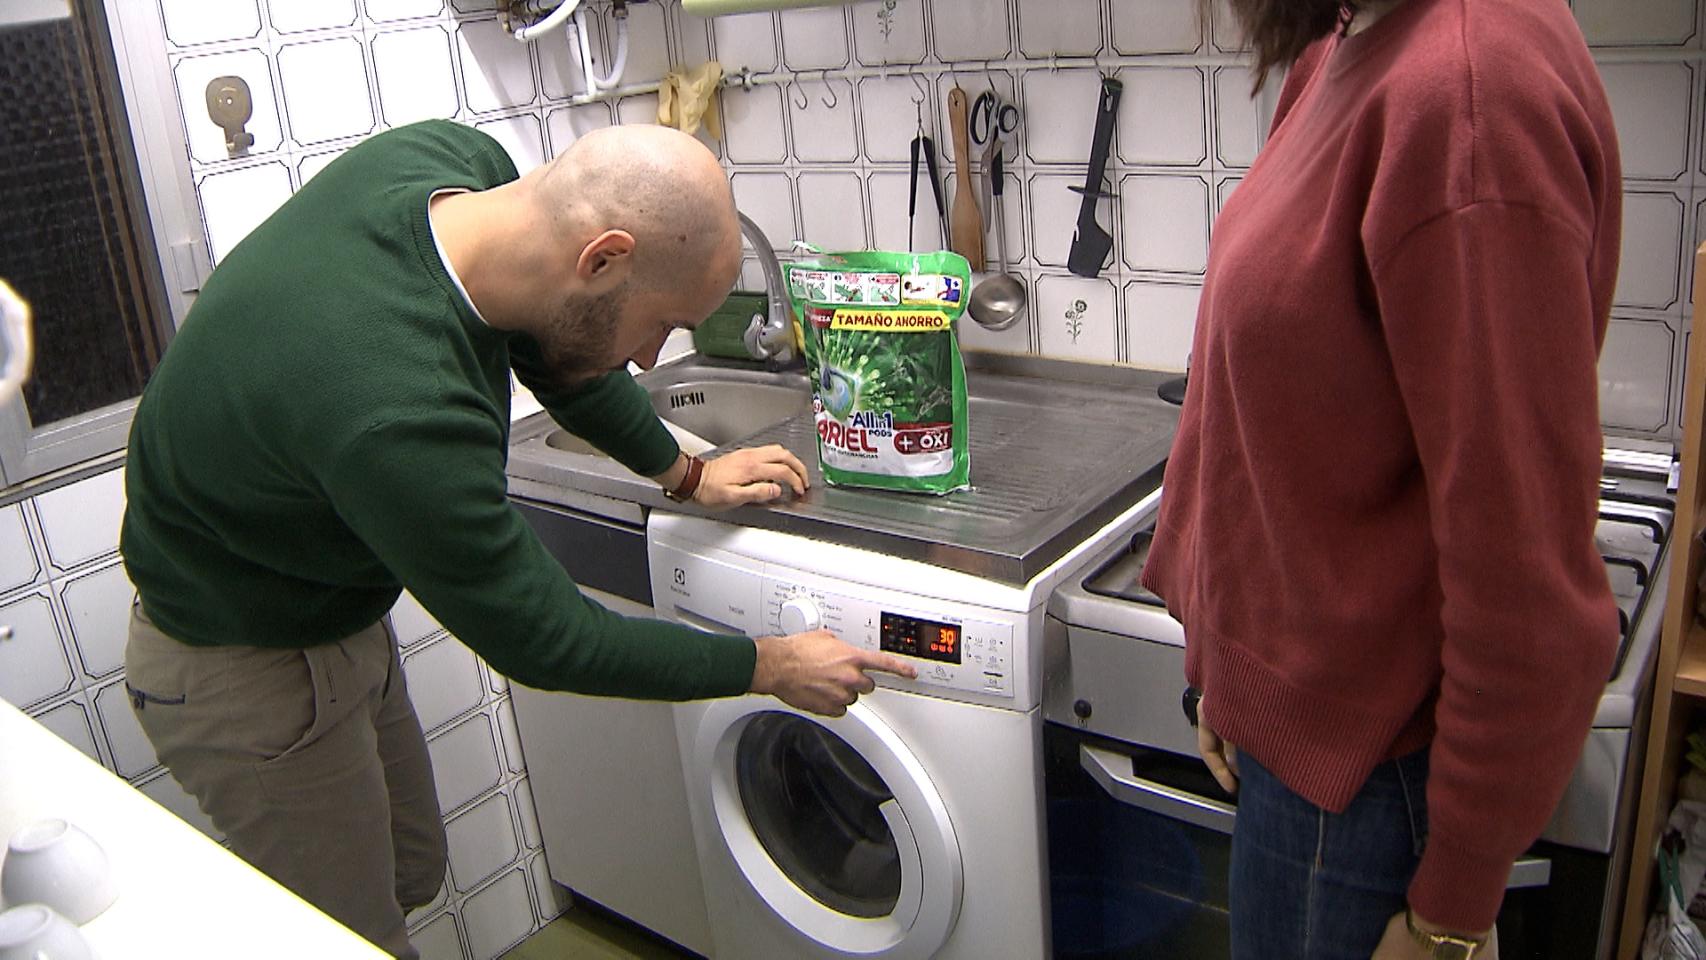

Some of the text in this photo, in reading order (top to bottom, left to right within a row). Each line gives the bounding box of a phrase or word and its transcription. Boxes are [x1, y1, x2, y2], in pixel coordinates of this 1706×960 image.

[836, 313, 893, 327] TAMAÑO
[895, 315, 943, 327] AHORRO
[817, 419, 878, 454] ARIEL
[868, 429, 893, 438] PODS
[940, 628, 955, 645] 30
